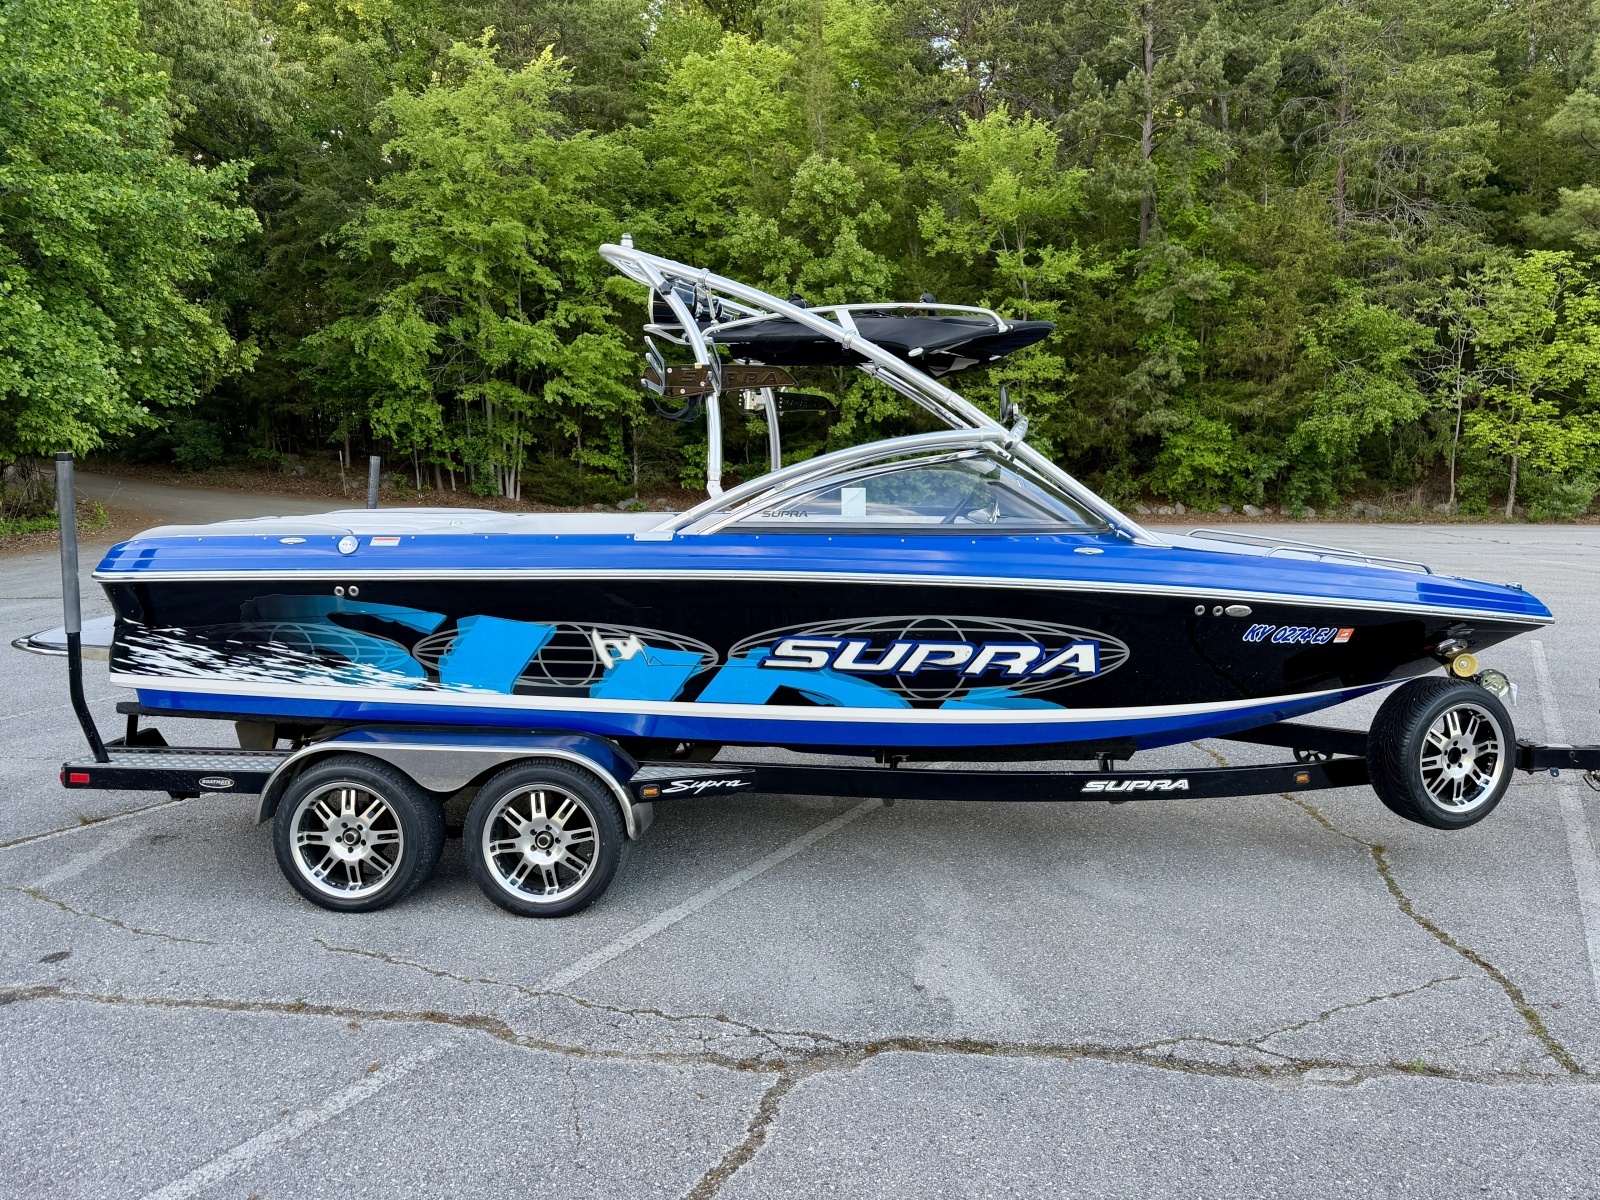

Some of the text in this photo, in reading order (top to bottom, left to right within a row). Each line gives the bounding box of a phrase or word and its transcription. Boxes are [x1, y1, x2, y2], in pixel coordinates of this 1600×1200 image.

[681, 371, 779, 384] SPRA
[761, 510, 809, 518] SUPRA
[1243, 624, 1337, 644] KY 0274 EJ
[757, 636, 1100, 676] SUPRA
[662, 780, 751, 794] Supra
[1081, 779, 1189, 792] SUPRA
